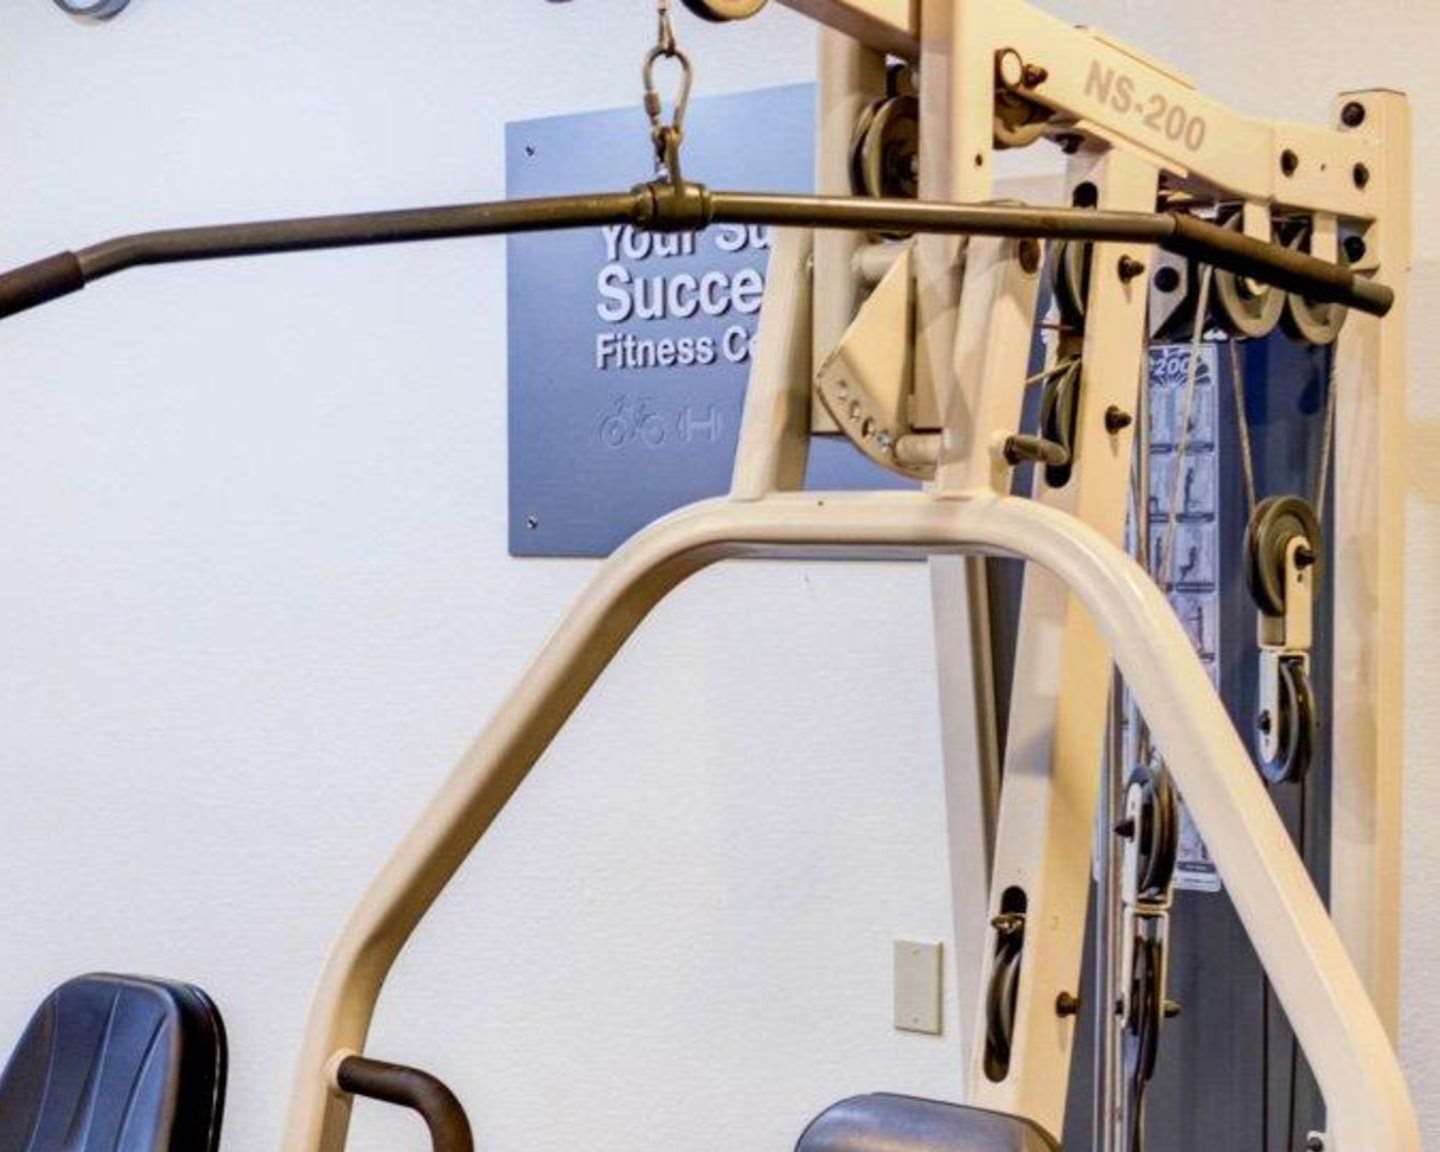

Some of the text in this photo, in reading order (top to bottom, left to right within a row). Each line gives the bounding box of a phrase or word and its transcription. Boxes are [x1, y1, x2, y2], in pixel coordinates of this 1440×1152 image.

[1083, 60, 1206, 151] NS-200
[596, 264, 764, 322] Succe
[596, 325, 757, 369] Fitness C
